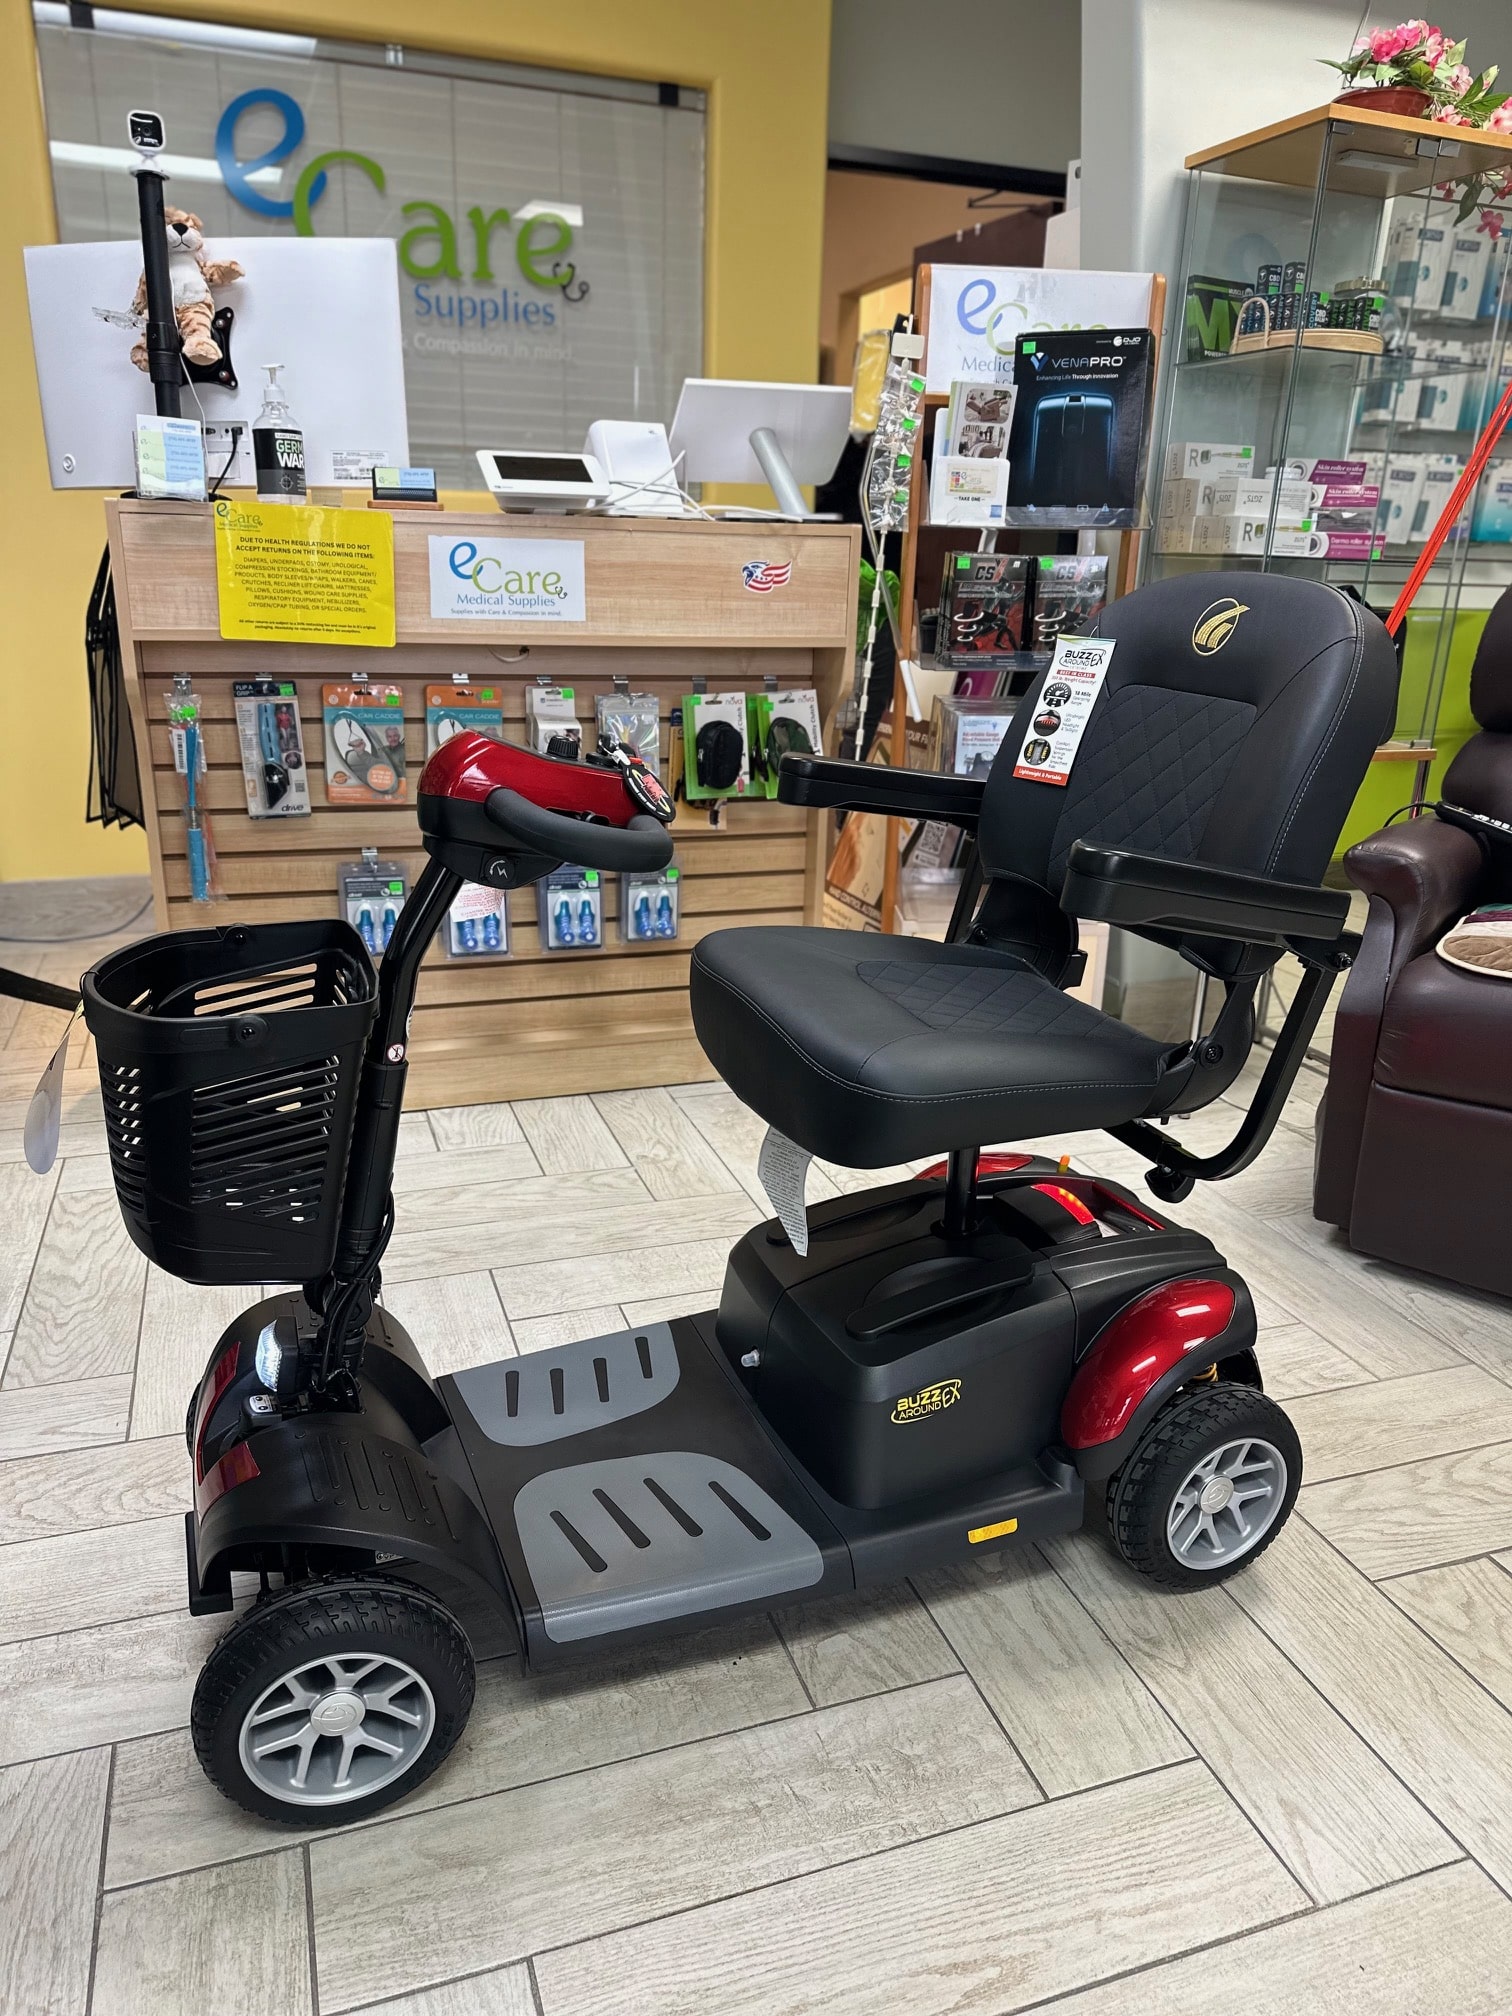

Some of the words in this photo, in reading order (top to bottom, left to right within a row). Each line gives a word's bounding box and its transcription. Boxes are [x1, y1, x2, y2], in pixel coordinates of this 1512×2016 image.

[215, 88, 574, 287] eCare
[414, 283, 556, 328] Supplies
[1308, 293, 1318, 328] COVERY
[413, 333, 508, 356] Compassion
[1051, 356, 1124, 368] VENAPRO
[216, 502, 261, 525] eCare
[291, 540, 335, 548] REGULATIONS
[262, 546, 291, 554] RETURNS
[317, 550, 353, 558] FOLLOWING
[449, 541, 562, 596] eCare
[456, 593, 504, 606] Medical
[508, 594, 556, 609] Supplies
[451, 608, 474, 616] Supplies
[508, 609, 540, 617] Compassion
[1064, 649, 1093, 660] BUZZ
[1063, 659, 1090, 667] AROUND
[725, 697, 743, 705] nova
[797, 695, 815, 703] nova
[1018, 768, 1041, 777] Lightweight
[1045, 772, 1062, 780] Portable
[281, 804, 304, 812] drive
[897, 1388, 942, 1411] BUZZ
[898, 1401, 942, 1420] AROUND
[942, 1381, 961, 1408] EX
